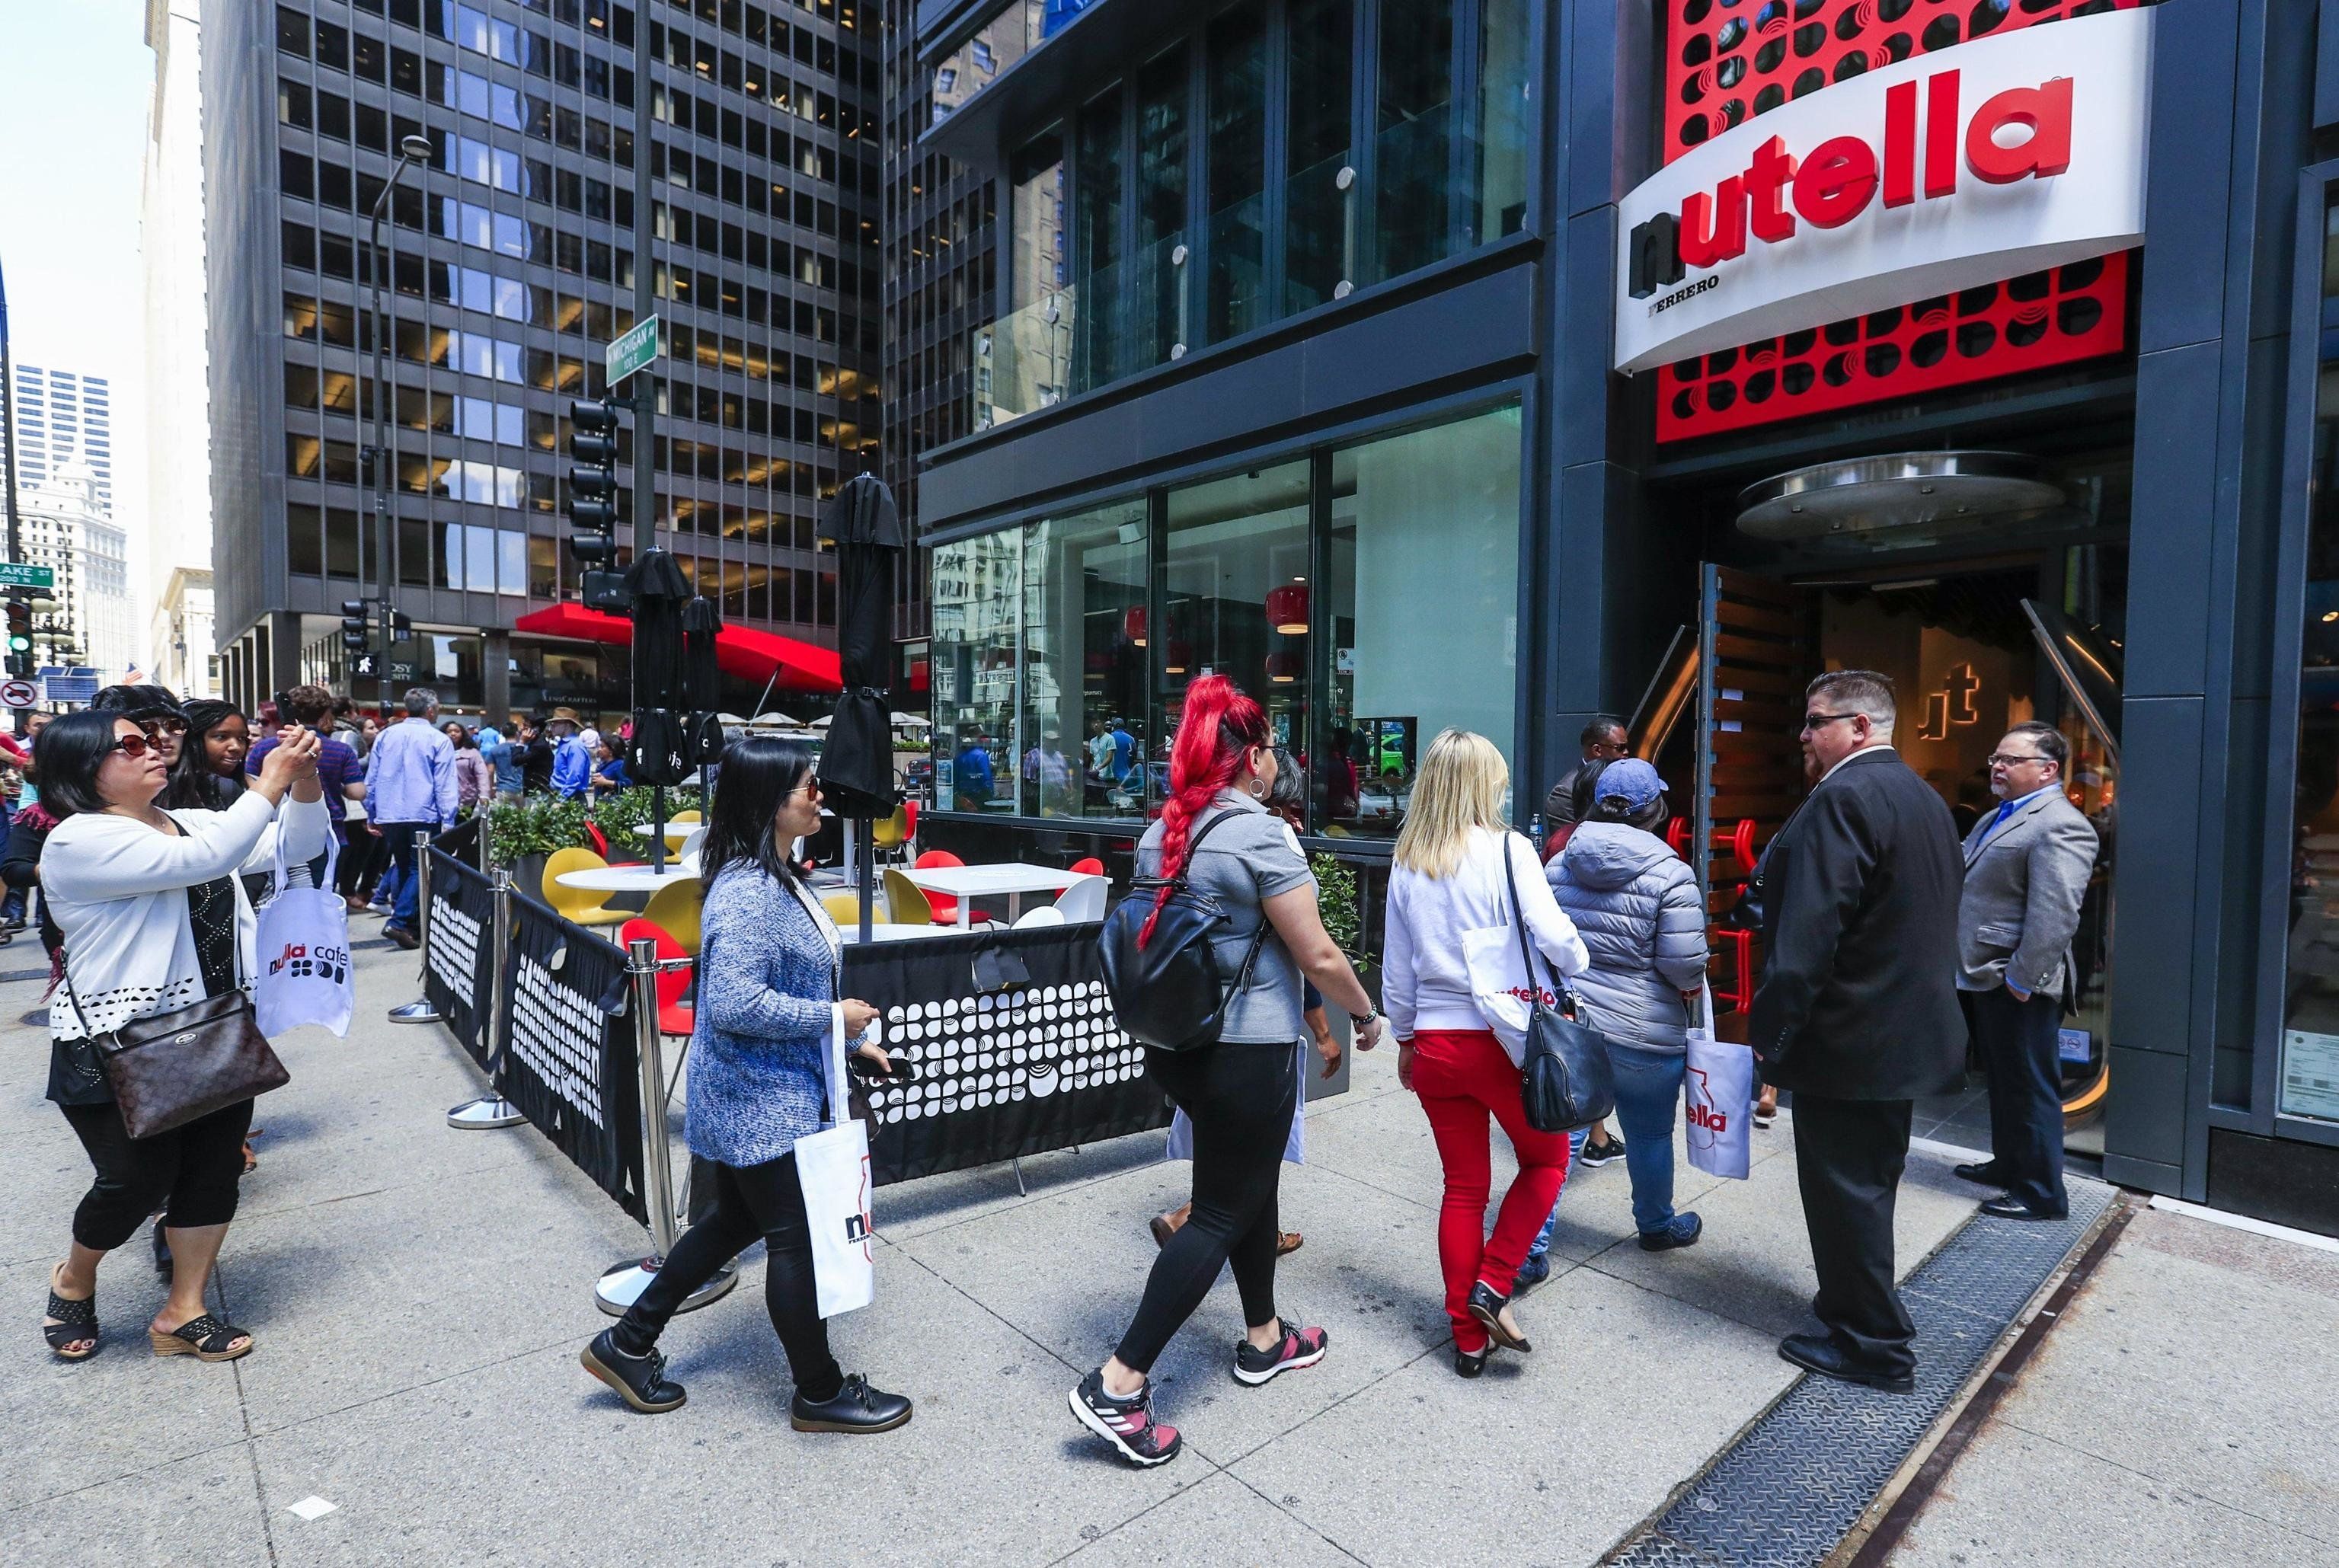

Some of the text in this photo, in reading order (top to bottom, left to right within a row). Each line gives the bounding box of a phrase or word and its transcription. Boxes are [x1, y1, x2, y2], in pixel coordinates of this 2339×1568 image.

[1629, 69, 2074, 299] nutella
[1648, 275, 1720, 318] FERRERO
[613, 327, 647, 363] MICHIGAN
[634, 353, 638, 364] E
[0, 566, 33, 576] AKE
[269, 944, 306, 976] nulla
[1687, 1103, 1727, 1132] ella
